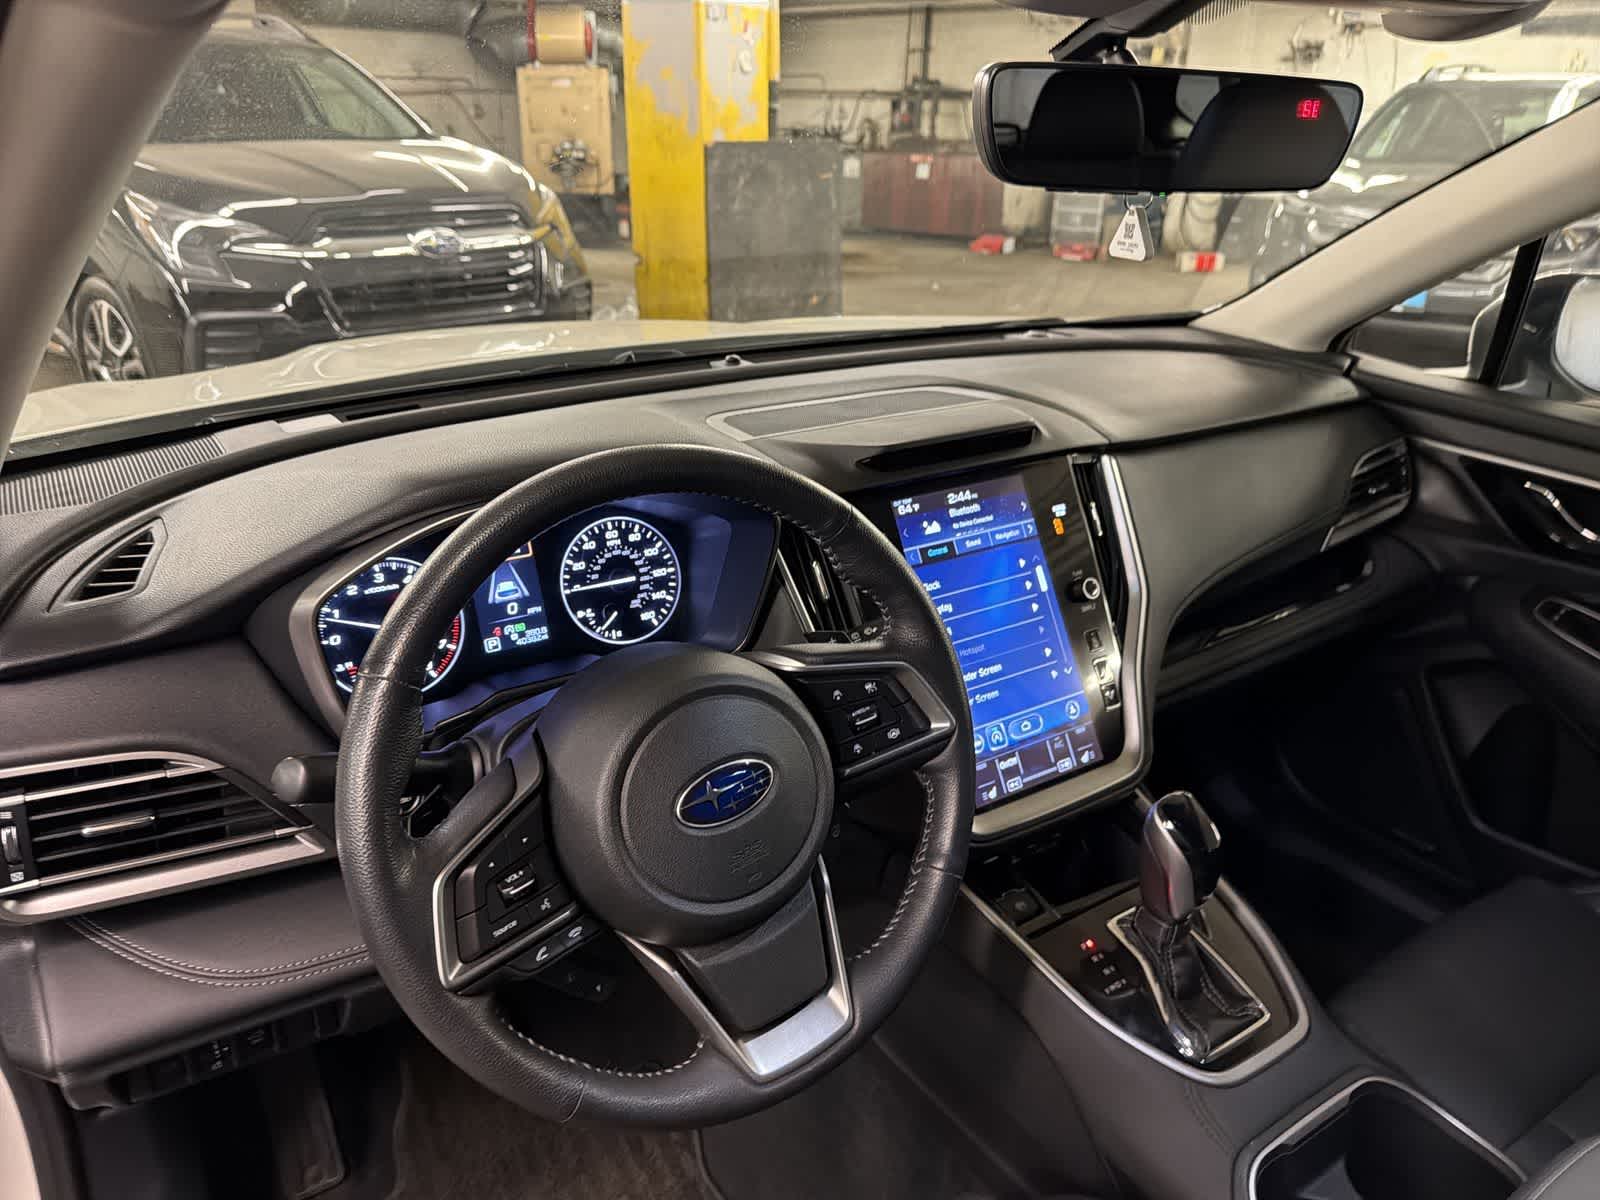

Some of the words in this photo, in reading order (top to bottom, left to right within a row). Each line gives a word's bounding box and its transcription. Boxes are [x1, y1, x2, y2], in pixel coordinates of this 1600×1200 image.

[947, 489, 972, 504] 2:44
[948, 503, 981, 518] Bluetooth
[605, 530, 618, 539] 60
[628, 532, 641, 542] 80
[582, 541, 596, 550] 40
[643, 548, 659, 558] 100
[572, 562, 585, 571] 20
[652, 567, 667, 577] 120
[373, 573, 385, 583] 3
[346, 585, 358, 596] 2
[651, 590, 667, 600] 140
[507, 602, 518, 615] 0
[331, 609, 340, 619] 1
[329, 635, 341, 646] 0
[978, 663, 1002, 678] Screen
[975, 690, 999, 705] Screen
